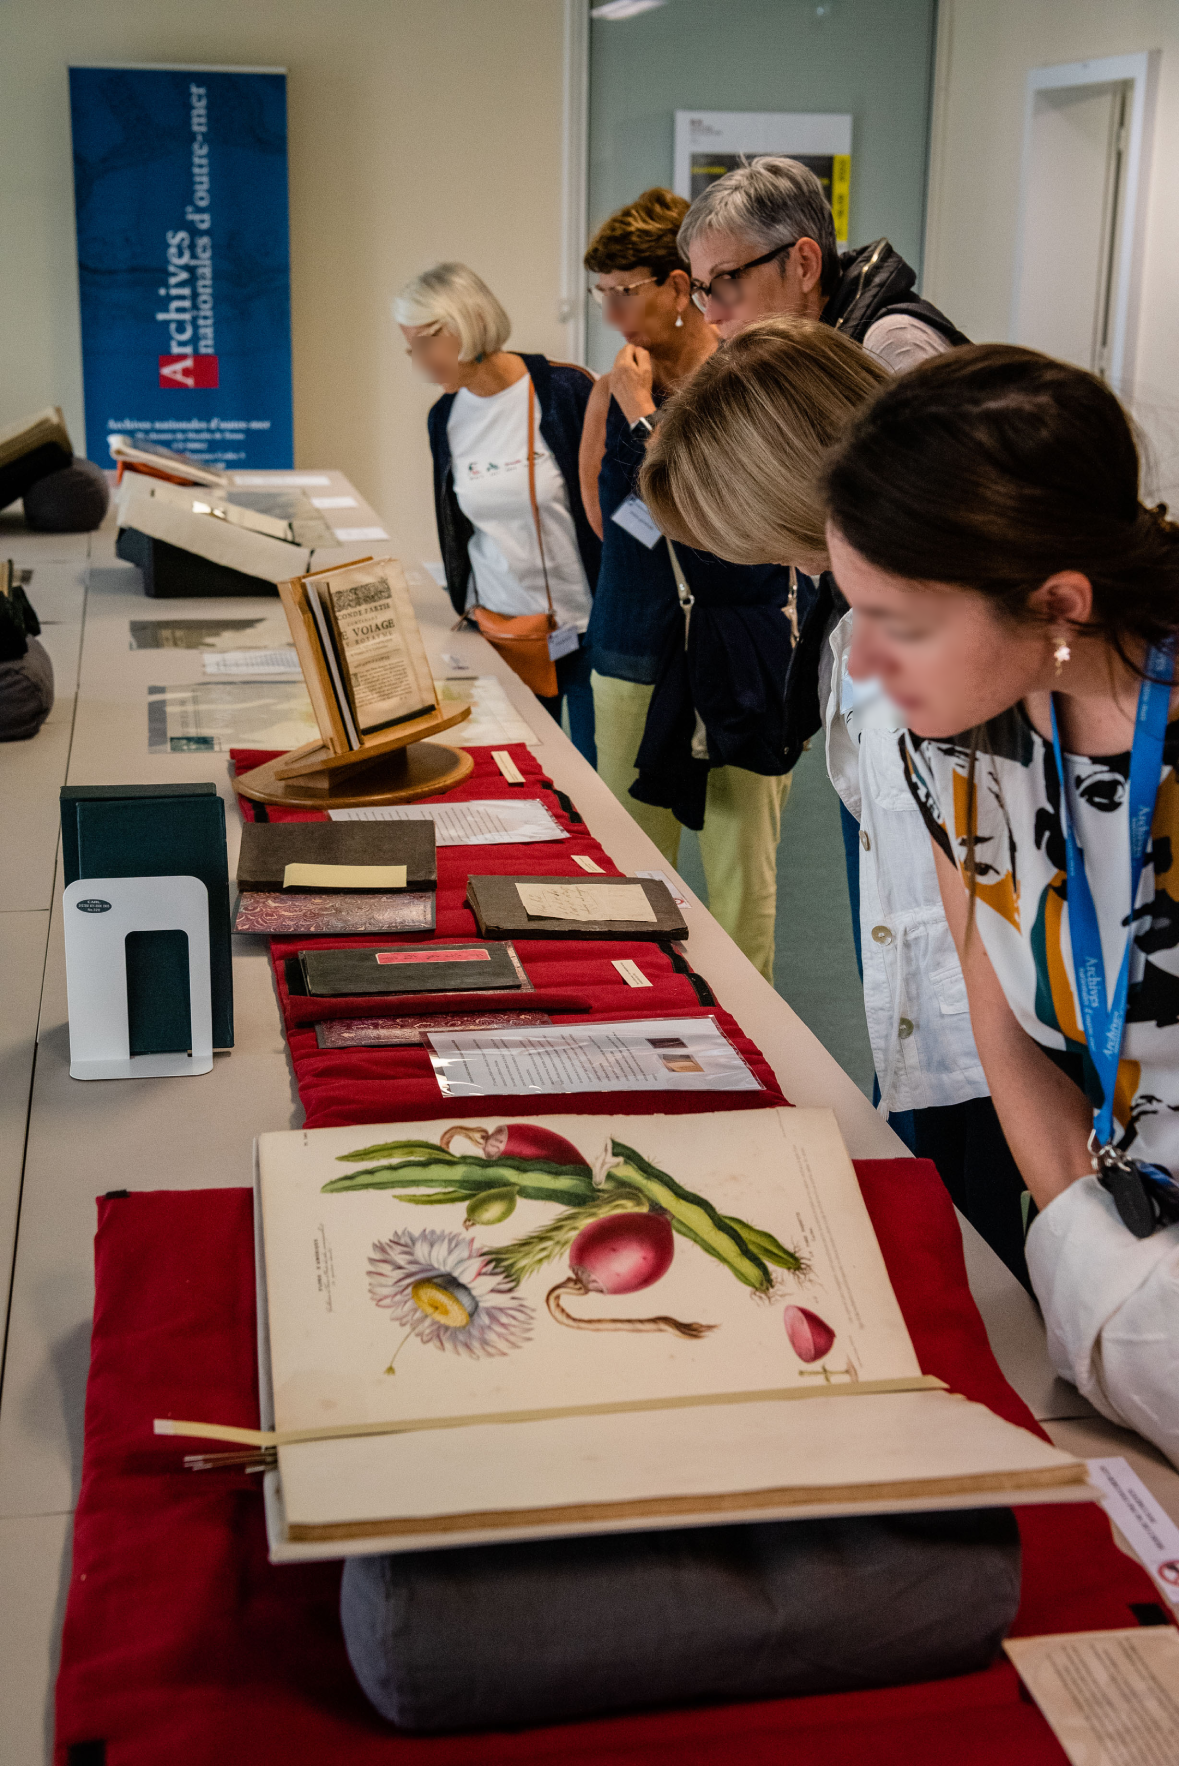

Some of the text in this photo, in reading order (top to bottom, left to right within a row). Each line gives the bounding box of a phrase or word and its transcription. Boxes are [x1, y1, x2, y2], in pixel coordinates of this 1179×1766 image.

[185, 83, 214, 355] nationales d'outre-mer
[155, 230, 194, 388] Archives
[337, 609, 362, 621] CONDE
[352, 618, 395, 638] VOIAGE
[1085, 955, 1103, 1008] Archives
